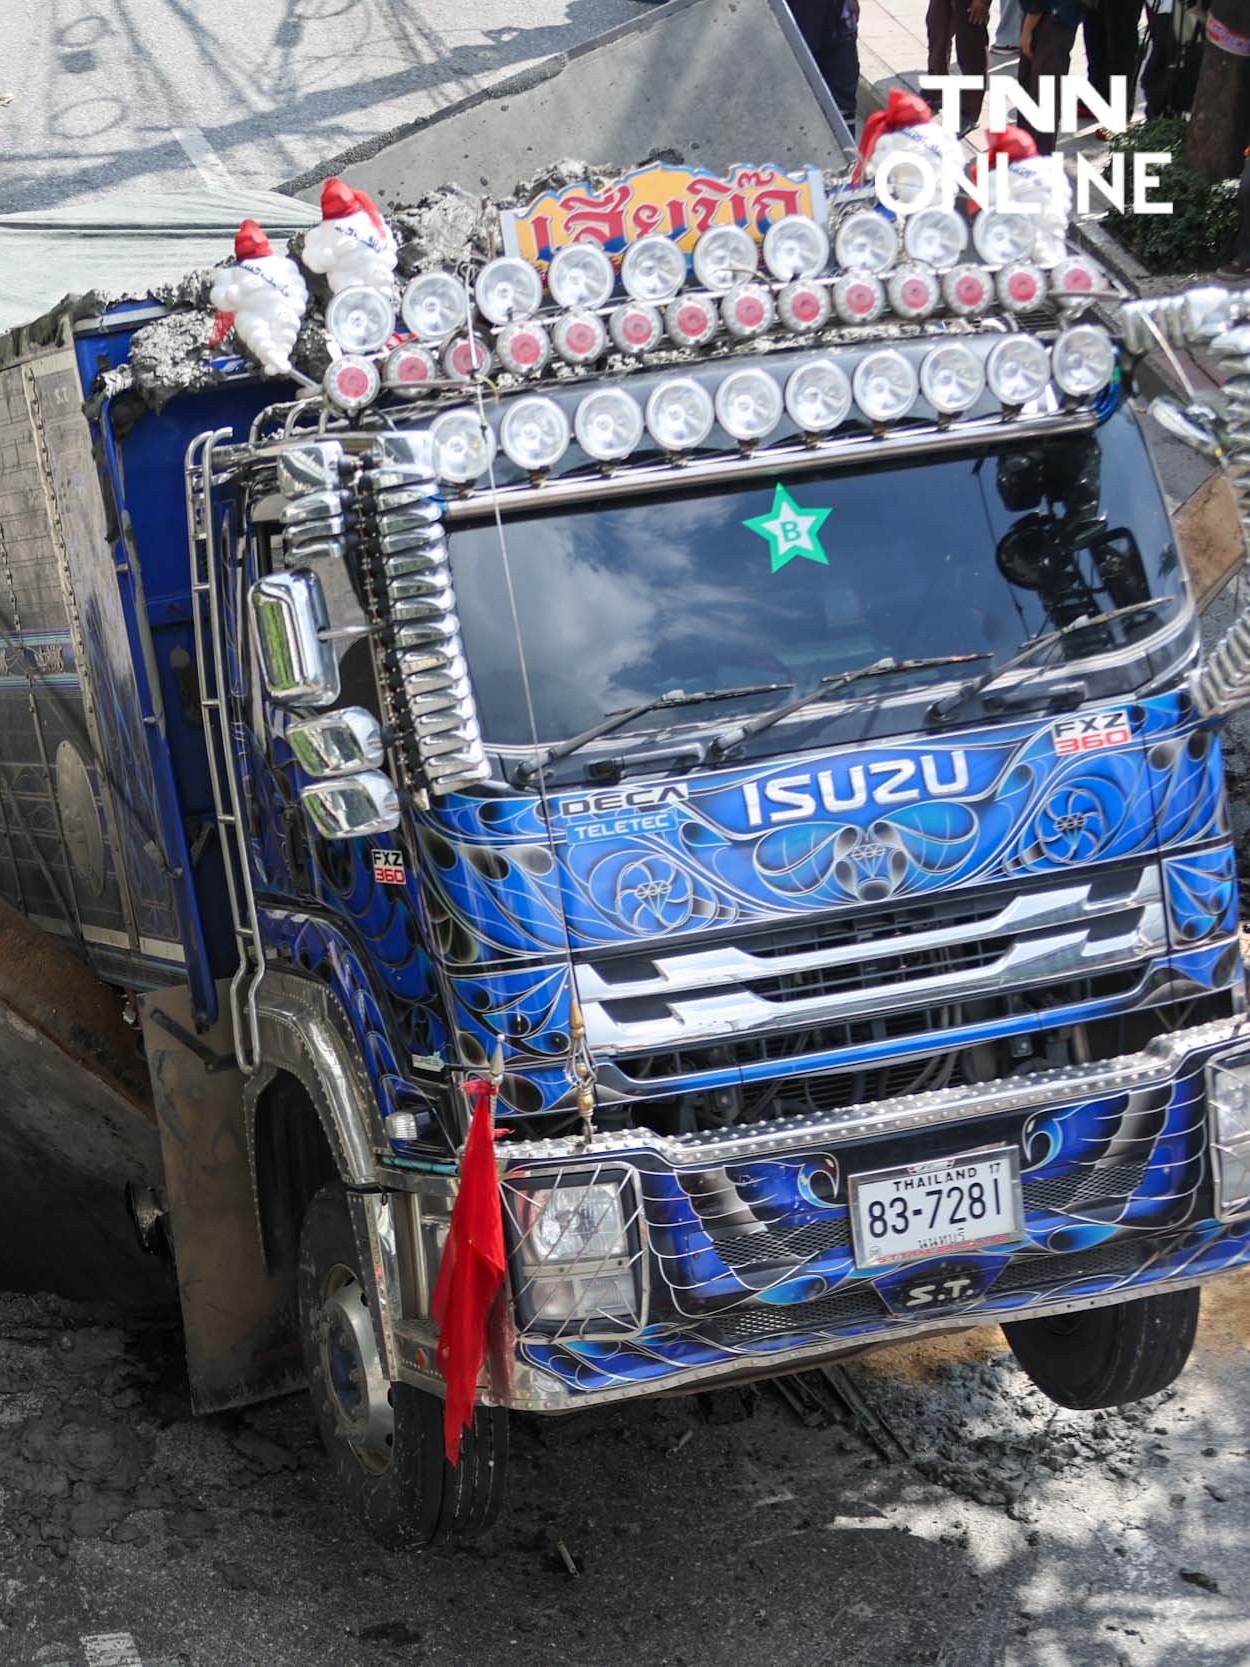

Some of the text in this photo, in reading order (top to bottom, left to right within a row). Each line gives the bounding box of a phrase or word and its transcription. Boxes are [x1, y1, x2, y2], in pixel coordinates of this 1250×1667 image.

[781, 521, 802, 542] B
[1053, 712, 1126, 738] FXZ
[1055, 729, 1130, 756] 360
[561, 785, 687, 817] DECA
[741, 750, 970, 827] ISUZU
[574, 813, 670, 840] TELETEC
[372, 850, 403, 866] FXZ
[374, 867, 406, 883] 360
[893, 1167, 978, 1192] THAILAND
[867, 1177, 1002, 1239] 83-7281
[905, 1279, 975, 1307] S.T.
